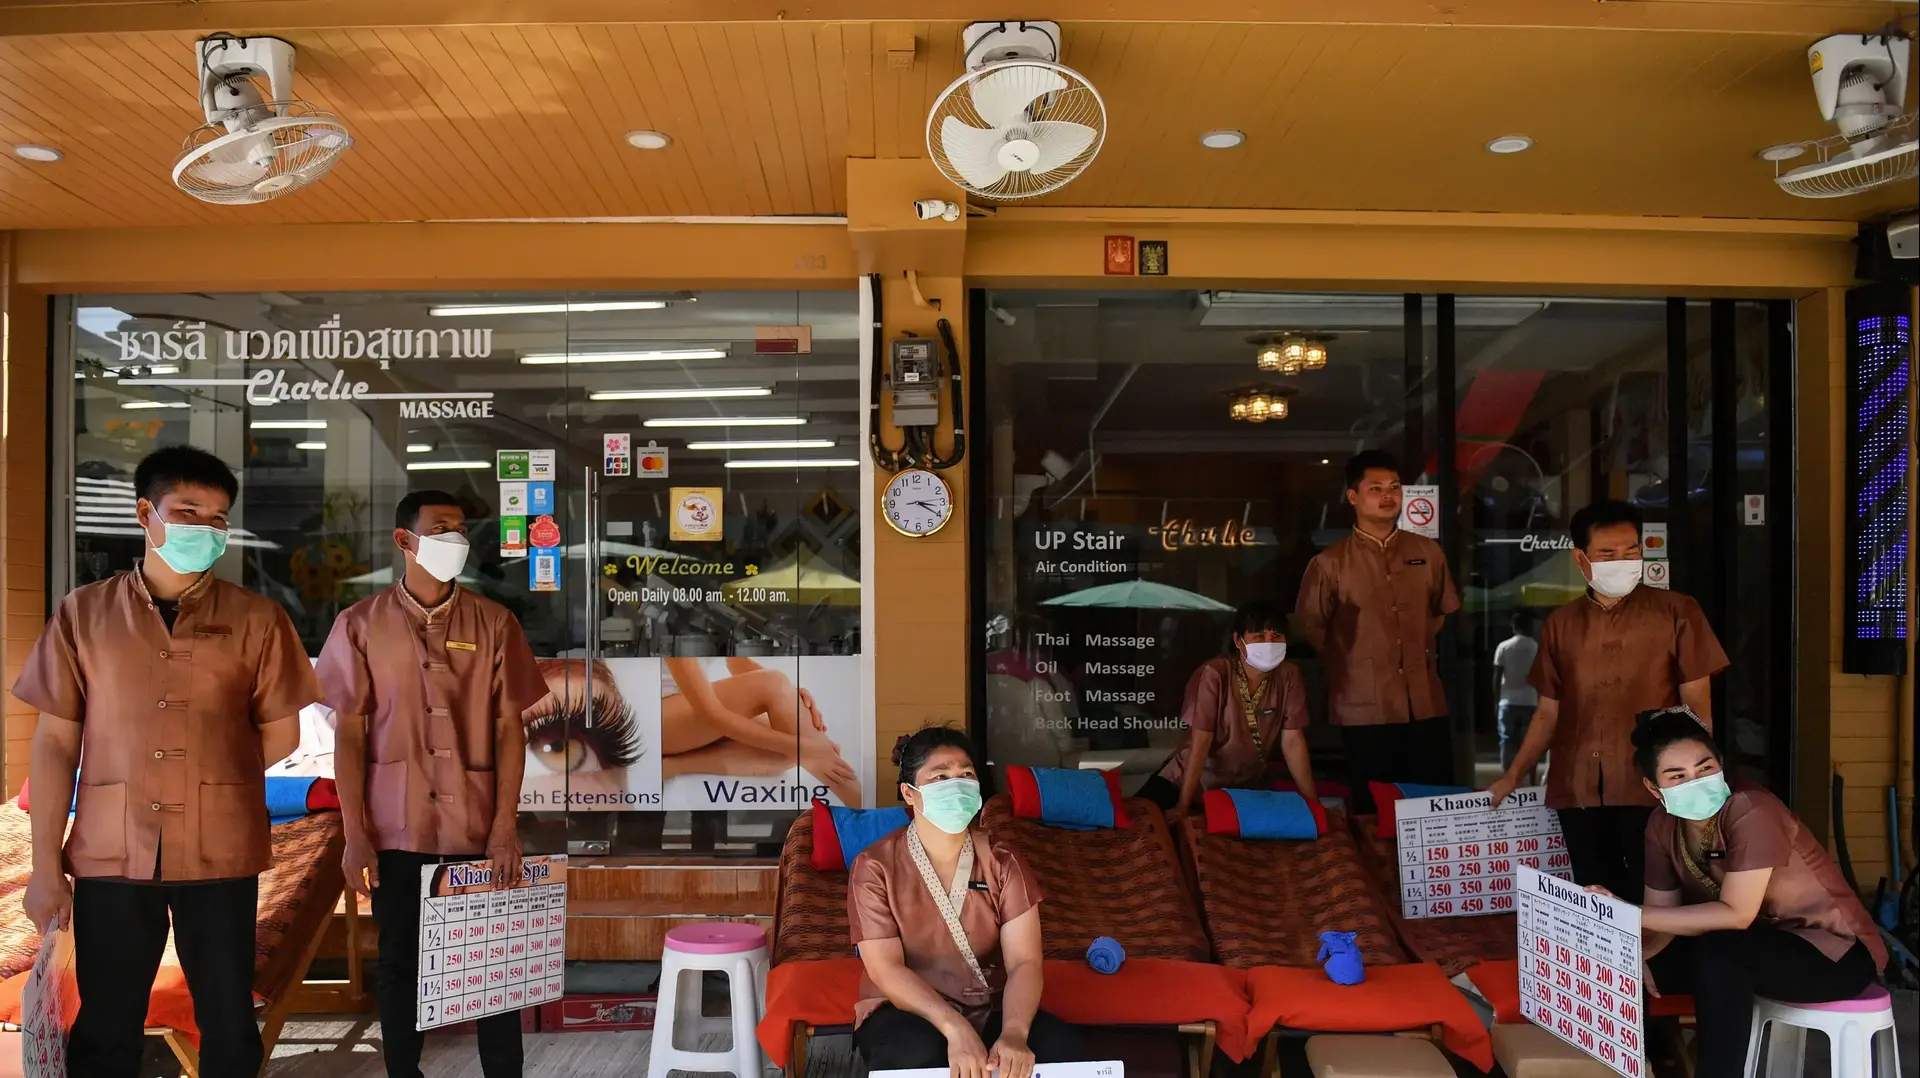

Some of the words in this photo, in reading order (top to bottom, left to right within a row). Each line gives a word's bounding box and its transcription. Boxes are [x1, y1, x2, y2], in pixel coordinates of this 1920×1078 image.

[119, 320, 207, 362] ชาร์ลี
[225, 313, 493, 370] นวดเพื่อสุขภาพ
[246, 368, 369, 406] Charlie
[399, 401, 495, 419] MASSAGE
[902, 479, 908, 487] 11
[912, 475, 921, 483] 12
[927, 478, 930, 486] 1
[935, 487, 941, 495] 2
[889, 500, 896, 508] 9
[940, 498, 945, 506] 3
[894, 512, 899, 520] 8
[904, 520, 909, 528] 7
[928, 519, 933, 527] 5
[915, 523, 921, 531] 6
[1034, 531, 1068, 550] UP
[1073, 531, 1125, 550] Stair
[1520, 534, 1575, 553] Charlie
[626, 555, 735, 576] Welcome
[1036, 561, 1056, 573] Air
[1060, 560, 1127, 573] Condition
[608, 588, 638, 605] Open
[642, 588, 670, 605] Daily
[673, 587, 702, 602] 08.00
[706, 591, 726, 602] am.
[737, 587, 766, 602] 12.00
[770, 590, 790, 602] am.
[1036, 634, 1070, 646] Thai
[1086, 634, 1155, 650] Massage
[1036, 662, 1057, 674] Oil
[1086, 662, 1155, 678] Massage
[1035, 690, 1070, 702] Foot
[1086, 690, 1156, 705] Massage
[1036, 717, 1072, 730] Back
[1077, 717, 1118, 730] Head
[552, 790, 660, 804] Extensions
[703, 780, 831, 806] Waxing
[1430, 796, 1492, 812] Khaosa
[1507, 791, 1538, 807] Spa
[1427, 847, 1449, 861] 150
[1458, 844, 1480, 858] 150
[1487, 842, 1508, 855] 180
[1516, 839, 1538, 852] 200
[522, 861, 549, 884] Spa
[1410, 869, 1415, 880] 1
[1427, 865, 1450, 879] 250
[1458, 862, 1481, 876] 250
[1487, 860, 1510, 874] 300
[1547, 853, 1570, 867] 400
[1428, 883, 1451, 897] 350
[1460, 880, 1482, 894] 350
[1489, 878, 1511, 891] 400
[1412, 906, 1418, 916] 2
[1429, 902, 1453, 915] 450
[1461, 898, 1483, 912] 450
[1490, 896, 1512, 909] 500
[1538, 875, 1587, 909] Khaosan
[1590, 895, 1613, 920] Spa
[448, 928, 463, 940] 150
[469, 925, 484, 937] 200
[491, 923, 505, 935] 150
[511, 919, 525, 931] 250
[531, 917, 544, 928] 180
[549, 913, 562, 925] 250
[429, 955, 435, 970] 1
[446, 952, 462, 966] 250
[468, 950, 483, 962] 350
[490, 946, 504, 958] 250
[510, 944, 524, 956] 400
[530, 940, 543, 952] 300
[549, 937, 561, 948] 400
[445, 978, 461, 991] 350
[467, 974, 482, 987] 500
[489, 970, 503, 983] 350
[509, 967, 523, 979] 550
[529, 961, 543, 975] 400
[548, 959, 561, 971] 550
[1535, 936, 1550, 956] 150
[1555, 944, 1570, 966] 150
[1575, 954, 1591, 976] 180
[1596, 964, 1613, 987] 200
[1619, 975, 1636, 998] 250
[1523, 954, 1528, 969] 1
[1536, 959, 1551, 979] 250
[1556, 969, 1571, 991] 250
[1575, 979, 1592, 1001] 300
[1596, 989, 1614, 1012] 350
[1619, 1001, 1637, 1024] 400
[427, 1005, 435, 1022] 2
[444, 1003, 460, 1016] 450
[466, 999, 482, 1011] 650
[488, 994, 503, 1007] 450
[509, 990, 522, 1002] 700
[528, 986, 542, 998] 500
[548, 982, 560, 993] 700
[1536, 982, 1551, 1003] 350
[1556, 993, 1572, 1014] 350
[1576, 1003, 1592, 1025] 400
[1597, 1014, 1614, 1037] 500
[1620, 1028, 1638, 1051] 550
[1525, 1000, 1531, 1014] 2
[1537, 1008, 1552, 1027] 450
[1557, 1017, 1573, 1039] 450
[1577, 1028, 1594, 1050] 500
[1599, 1040, 1615, 1063] 650
[1621, 1053, 1639, 1077] 700
